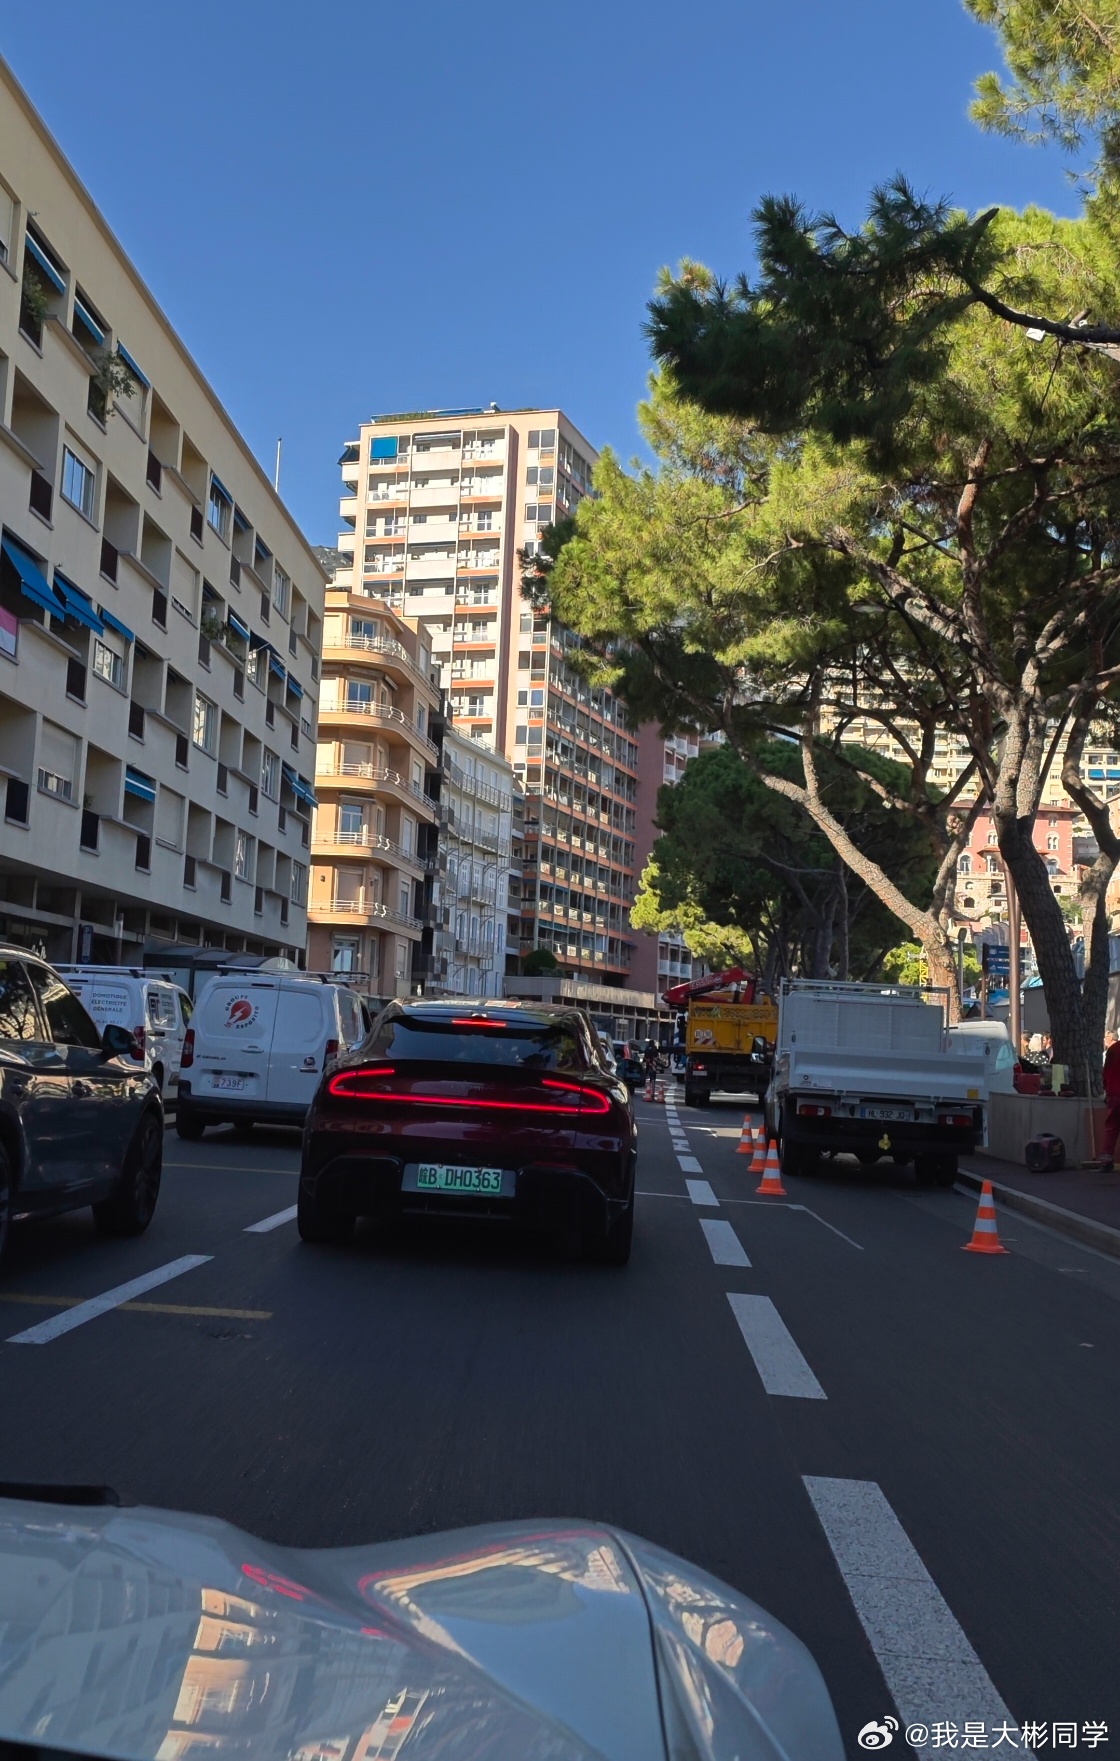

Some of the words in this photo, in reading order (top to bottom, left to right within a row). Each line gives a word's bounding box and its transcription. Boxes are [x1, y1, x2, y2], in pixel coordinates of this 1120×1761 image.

[92, 992, 127, 1000] DOMOTIQUE
[220, 1079, 242, 1089] 739F
[444, 1168, 500, 1190] DH0363
